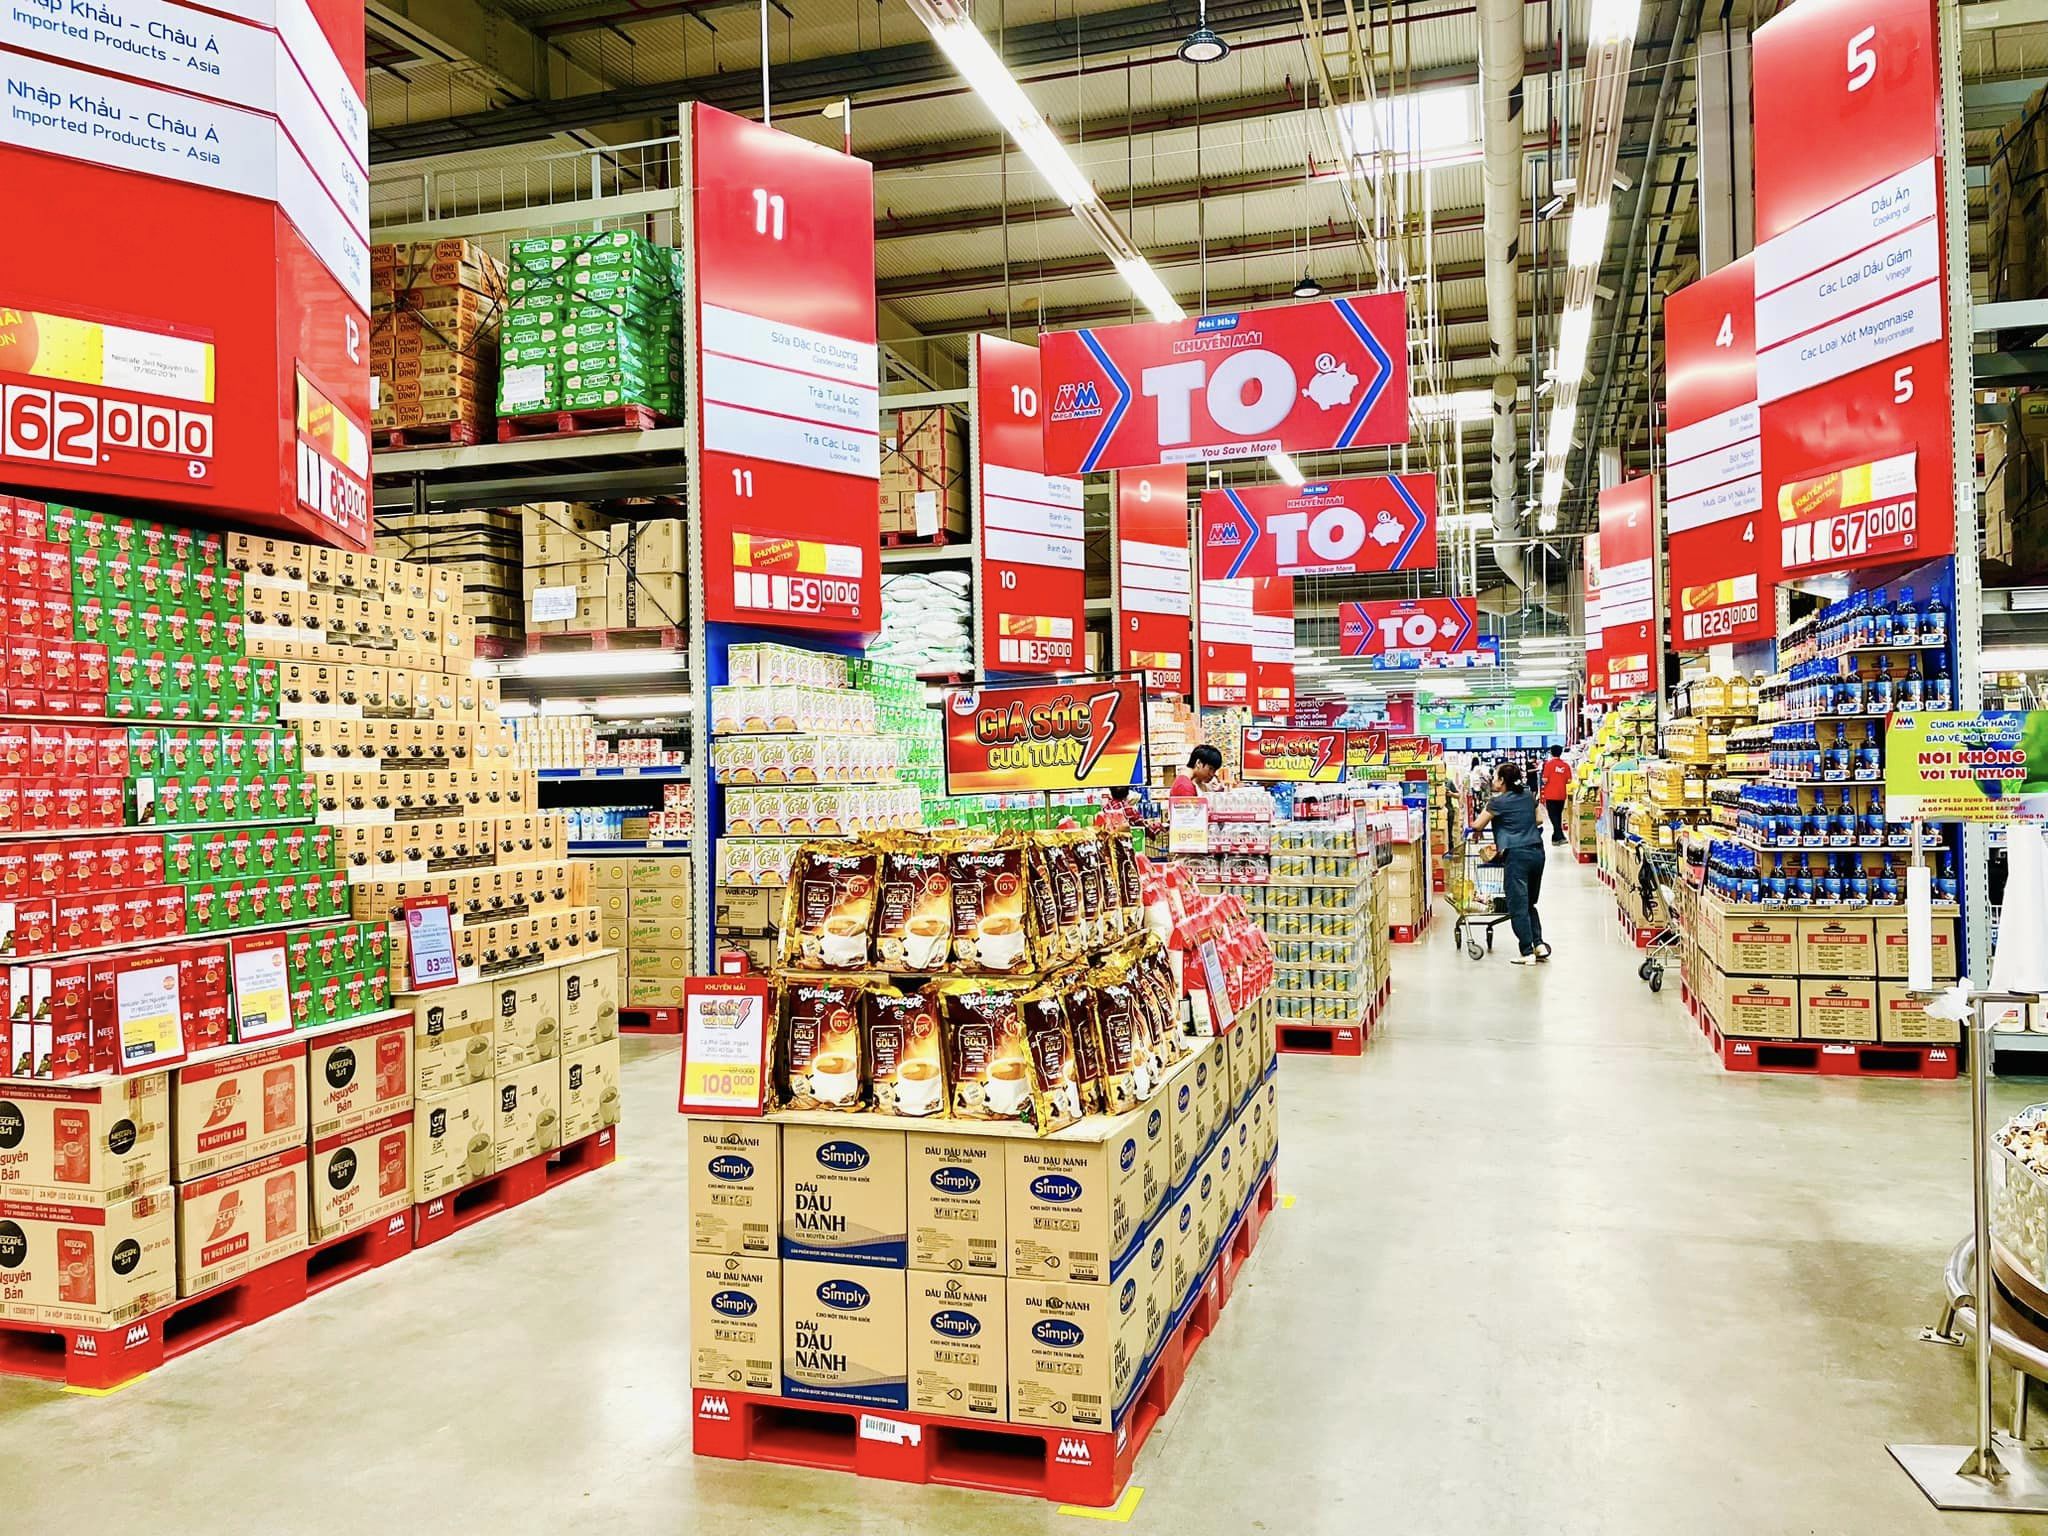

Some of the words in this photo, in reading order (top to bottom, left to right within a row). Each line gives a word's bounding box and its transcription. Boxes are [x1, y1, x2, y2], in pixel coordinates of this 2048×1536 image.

[12, 8, 88, 40] Imported
[95, 30, 166, 61] Products
[187, 57, 220, 75] Asia
[1848, 24, 1876, 92] 5
[12, 105, 87, 135] Imported
[94, 123, 166, 153] Products
[187, 146, 220, 164] Asia
[147, 112, 197, 138] Châu
[753, 188, 784, 240] 11
[1873, 208, 1900, 227] Cooking
[1885, 265, 1912, 281] Vinegar
[1715, 313, 1733, 347] 4
[1859, 309, 1914, 337] Mayonnaise
[1874, 324, 1914, 346] Mayonnaise
[1894, 366, 1914, 404] 5
[1011, 384, 1037, 418] 10
[1142, 349, 1297, 446] TO
[1202, 448, 1220, 457] You
[1222, 446, 1248, 455] Save
[1250, 444, 1276, 453] More
[732, 468, 753, 498] 11
[1139, 480, 1151, 503] 9
[1266, 507, 1366, 565] TO
[1743, 522, 1755, 543] 4
[760, 552, 793, 568] PROMOTION
[1000, 571, 1017, 590] 10
[1130, 617, 1138, 630] 9
[1378, 614, 1438, 647] TO
[1640, 625, 1647, 638] 2
[978, 702, 1028, 743] GIÁ
[1032, 695, 1092, 740] SỐC
[1260, 736, 1286, 756] GIÁ
[1977, 768, 2026, 779] NYLON
[930, 882, 944, 891] 10%
[956, 894, 976, 904] GOLD
[794, 1029, 814, 1040] GOLD
[833, 1020, 848, 1028] 10%
[876, 1037, 898, 1048] GOLD
[822, 1145, 866, 1166] Simply
[713, 1158, 750, 1179] Simply
[936, 1170, 977, 1190] Simply
[1035, 1178, 1078, 1198] Simply
[716, 1294, 753, 1313] Simply
[822, 1283, 866, 1305] Simply
[936, 1314, 977, 1334] Simply
[1037, 1323, 1080, 1343] Simply
